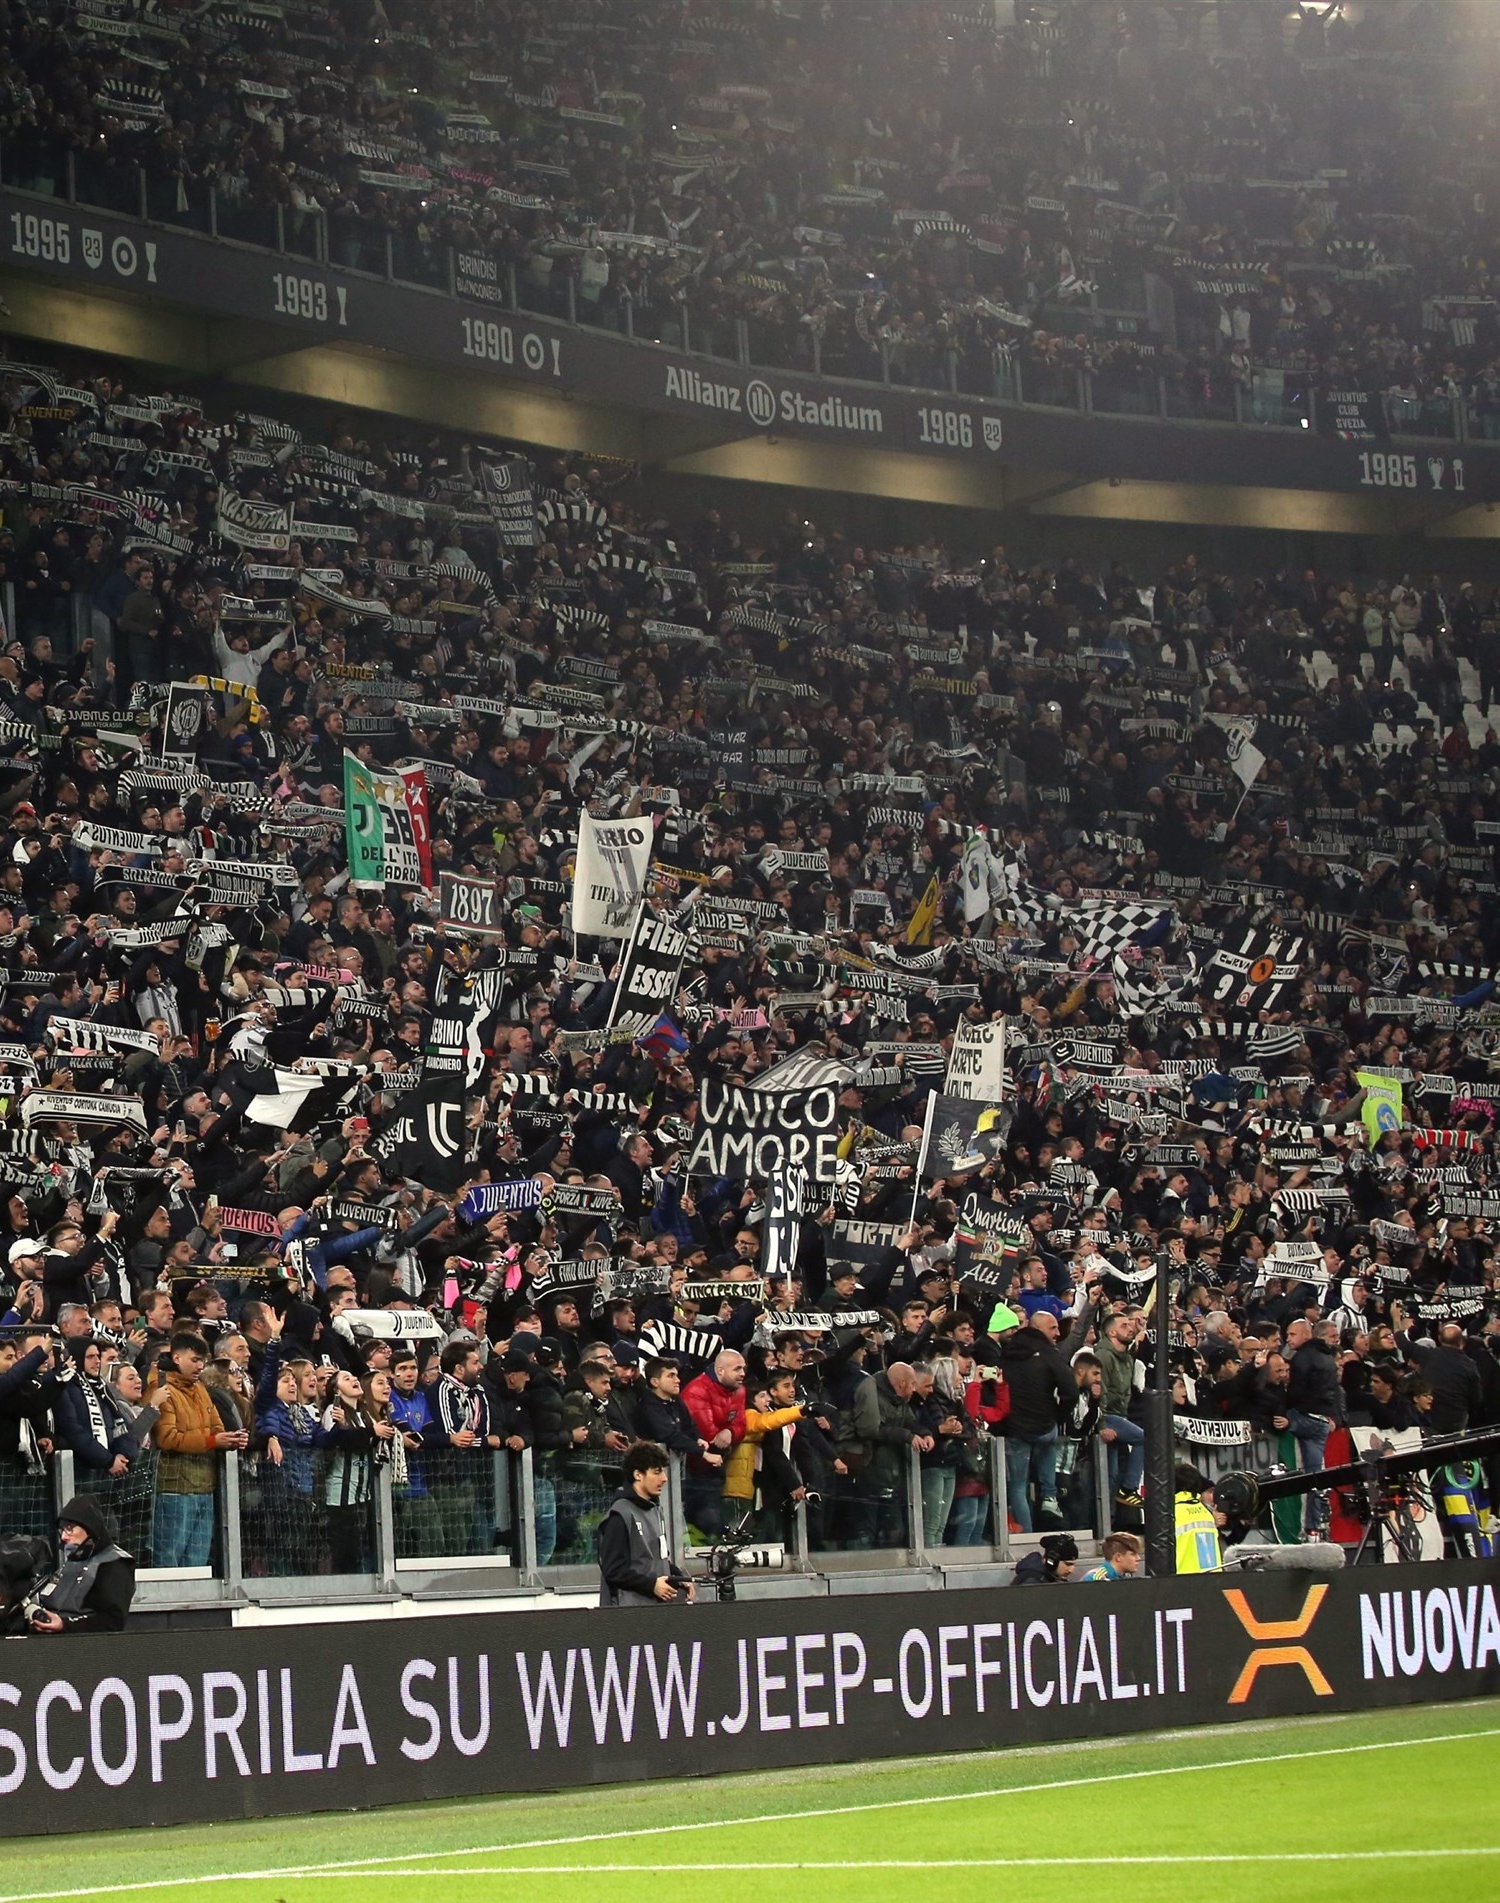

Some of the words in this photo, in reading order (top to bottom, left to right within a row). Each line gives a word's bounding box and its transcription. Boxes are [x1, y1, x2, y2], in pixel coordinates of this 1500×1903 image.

[11, 213, 70, 264] 1995
[85, 234, 100, 259] 23
[458, 252, 498, 281] BRINDISI
[273, 273, 327, 322] 1993
[462, 317, 514, 364] 1990
[665, 365, 741, 413] Allianz
[780, 391, 883, 433] Stadium
[1327, 390, 1368, 404] JUVENTUS
[1338, 405, 1359, 416] CLUB
[919, 408, 972, 448] 1986
[985, 422, 1000, 441] 22
[1336, 417, 1366, 430] SVEZIA
[1359, 452, 1416, 488] 1985
[546, 685, 592, 700] CAMPIONI
[69, 710, 110, 721] JUVENTUS
[113, 710, 133, 721] CLUB
[460, 697, 506, 716] JUVENTUS
[728, 732, 746, 744] VAR
[722, 752, 742, 764] BAR
[782, 853, 825, 873] JUVENTUS
[449, 882, 493, 926] 1897
[508, 951, 538, 966] JUVENTUS
[1071, 1043, 1113, 1066] JUVENTUS
[1086, 1074, 1130, 1089] JUVENTUS
[700, 1078, 836, 1130] UNICO
[688, 1130, 838, 1184] AMORE
[475, 1180, 541, 1213] JUVENTUS
[553, 1191, 581, 1208] FORZA
[590, 1195, 615, 1210] JUVE
[335, 1201, 384, 1224] JUVENTUS
[558, 1262, 576, 1278] FINO
[577, 1260, 595, 1277] ALLA
[597, 1258, 613, 1273] FINE
[963, 1263, 998, 1286] Alti
[1270, 1260, 1314, 1278] JUVENTUS
[717, 1285, 738, 1299] PER
[740, 1282, 762, 1298] NOI
[404, 1317, 433, 1330] JUVENTUS
[1360, 1583, 1500, 1680] NUOVA
[400, 1654, 490, 1762] SU
[515, 1606, 1193, 1750] WWW.JEEP-OFFICIAL.IT
